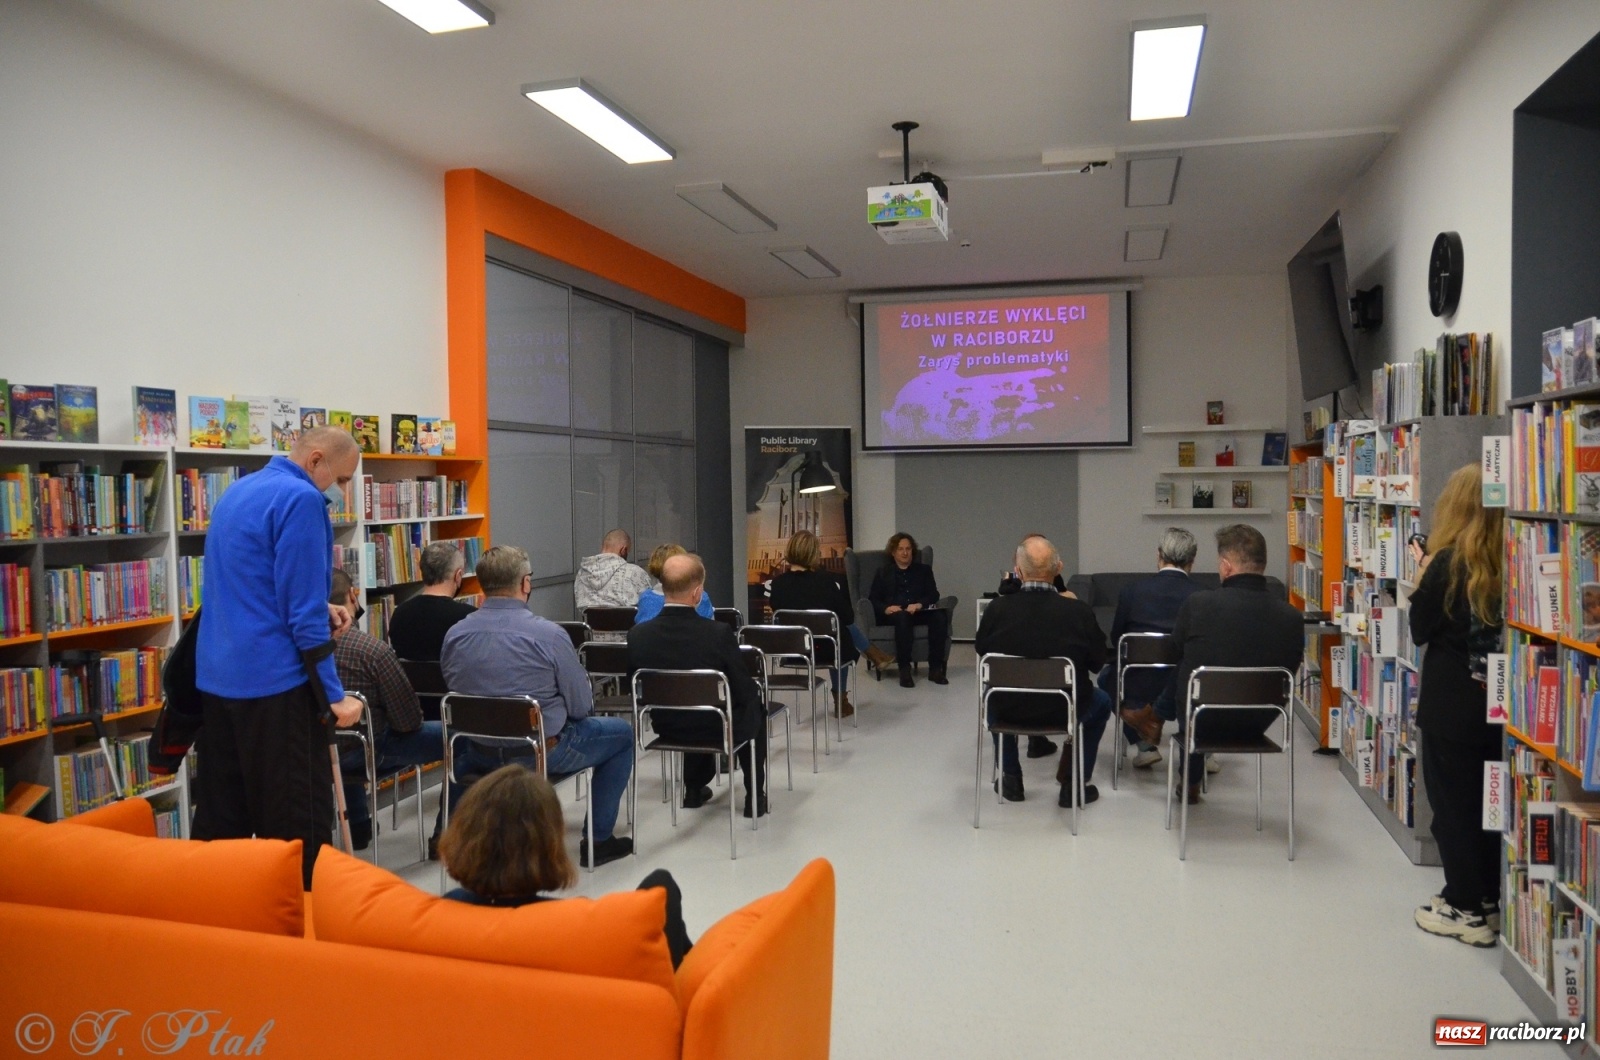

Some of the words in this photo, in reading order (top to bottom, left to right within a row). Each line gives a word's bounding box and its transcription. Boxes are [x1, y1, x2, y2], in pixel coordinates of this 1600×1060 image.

[901, 309, 999, 328] ŻOŁNIERZE
[1005, 305, 1087, 324] WYKLĘCI
[931, 333, 947, 348] W
[953, 328, 1054, 347] RACIBORZU
[918, 354, 961, 370] Zarys
[966, 350, 1070, 368] problematyki
[760, 436, 787, 445] Public
[788, 436, 818, 446] Library
[760, 445, 798, 453] Raciborz
[1549, 585, 1560, 631] RYSUNEK
[1496, 659, 1505, 702] ORIGAMI
[1539, 685, 1548, 724] ZWYCZAJE
[1548, 685, 1557, 723] OBYCZAJE
[1364, 756, 1372, 785] NAUKA
[1489, 765, 1500, 805] SPORT
[1535, 818, 1549, 862] NETFLIX
[1565, 967, 1579, 1018] HOBBY
